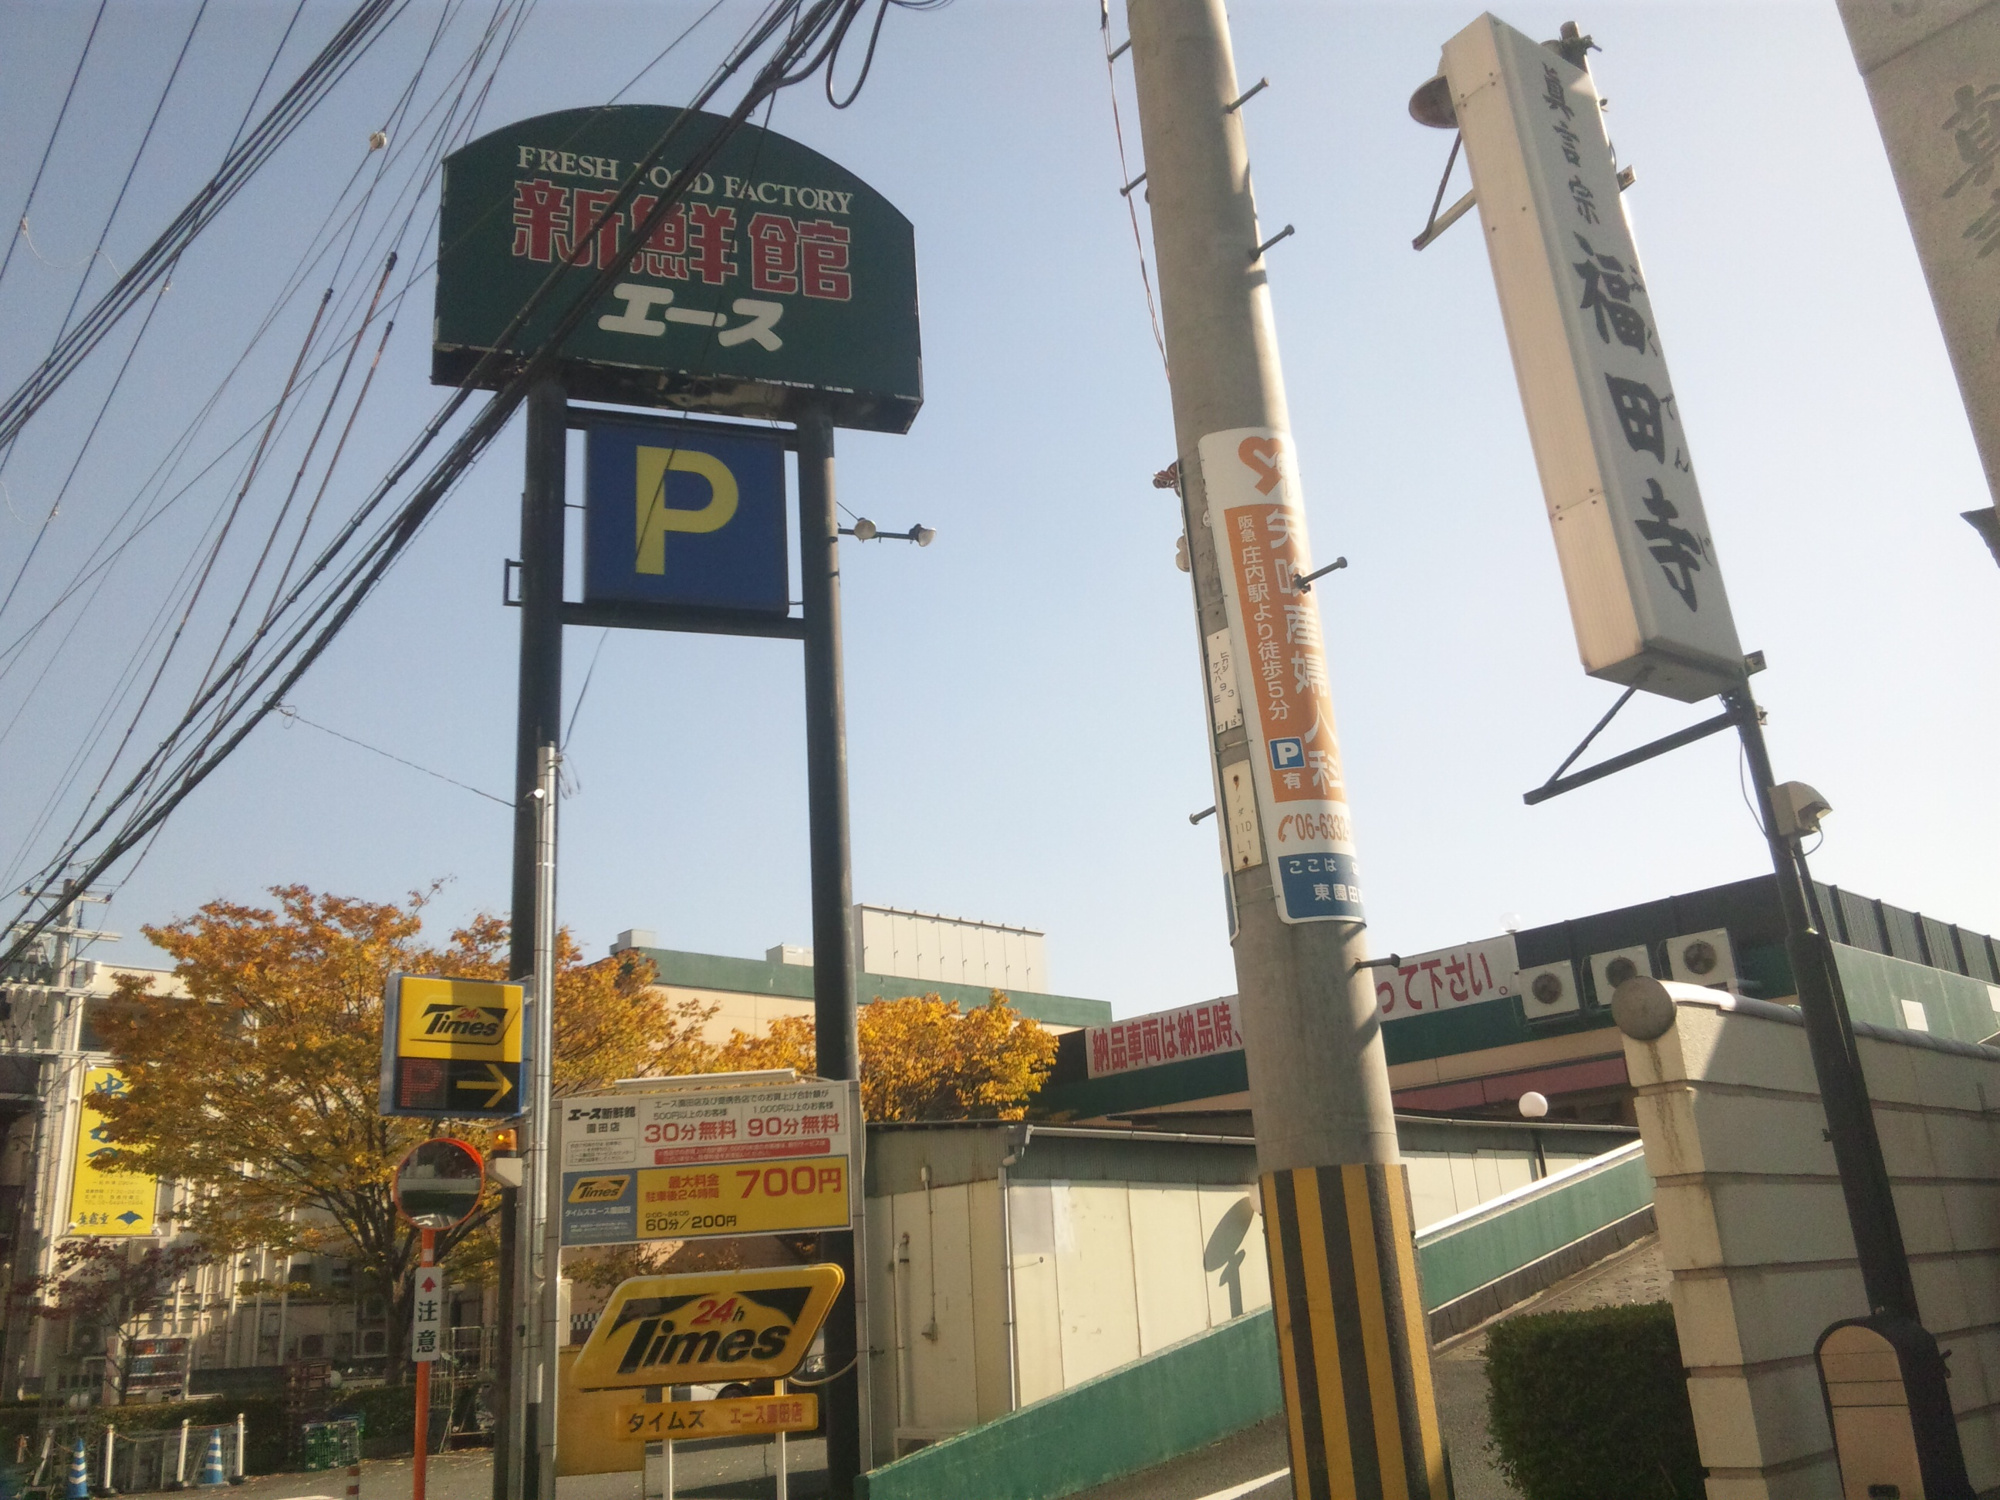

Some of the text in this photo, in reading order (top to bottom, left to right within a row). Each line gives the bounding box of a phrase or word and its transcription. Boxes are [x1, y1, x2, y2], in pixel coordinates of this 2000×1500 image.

[517, 145, 618, 182] FRESH
[724, 175, 853, 215] FACTORY
[512, 178, 852, 301] 新鮮館
[598, 282, 784, 352] エース
[1573, 231, 1701, 612] 福田寺
[635, 445, 739, 575] P
[1282, 772, 1301, 790] 有
[1288, 856, 1337, 875] ここは
[423, 1009, 501, 1037] Times
[644, 1119, 738, 1143] 30分無料
[747, 1112, 840, 1137] 90分無料
[668, 1173, 720, 1189] 最大料金
[735, 1165, 842, 1199] 700円
[415, 1299, 438, 1354] 注意
[690, 1297, 745, 1326] 24h
[613, 1309, 793, 1375] Times
[628, 1409, 705, 1433] タイムズ
